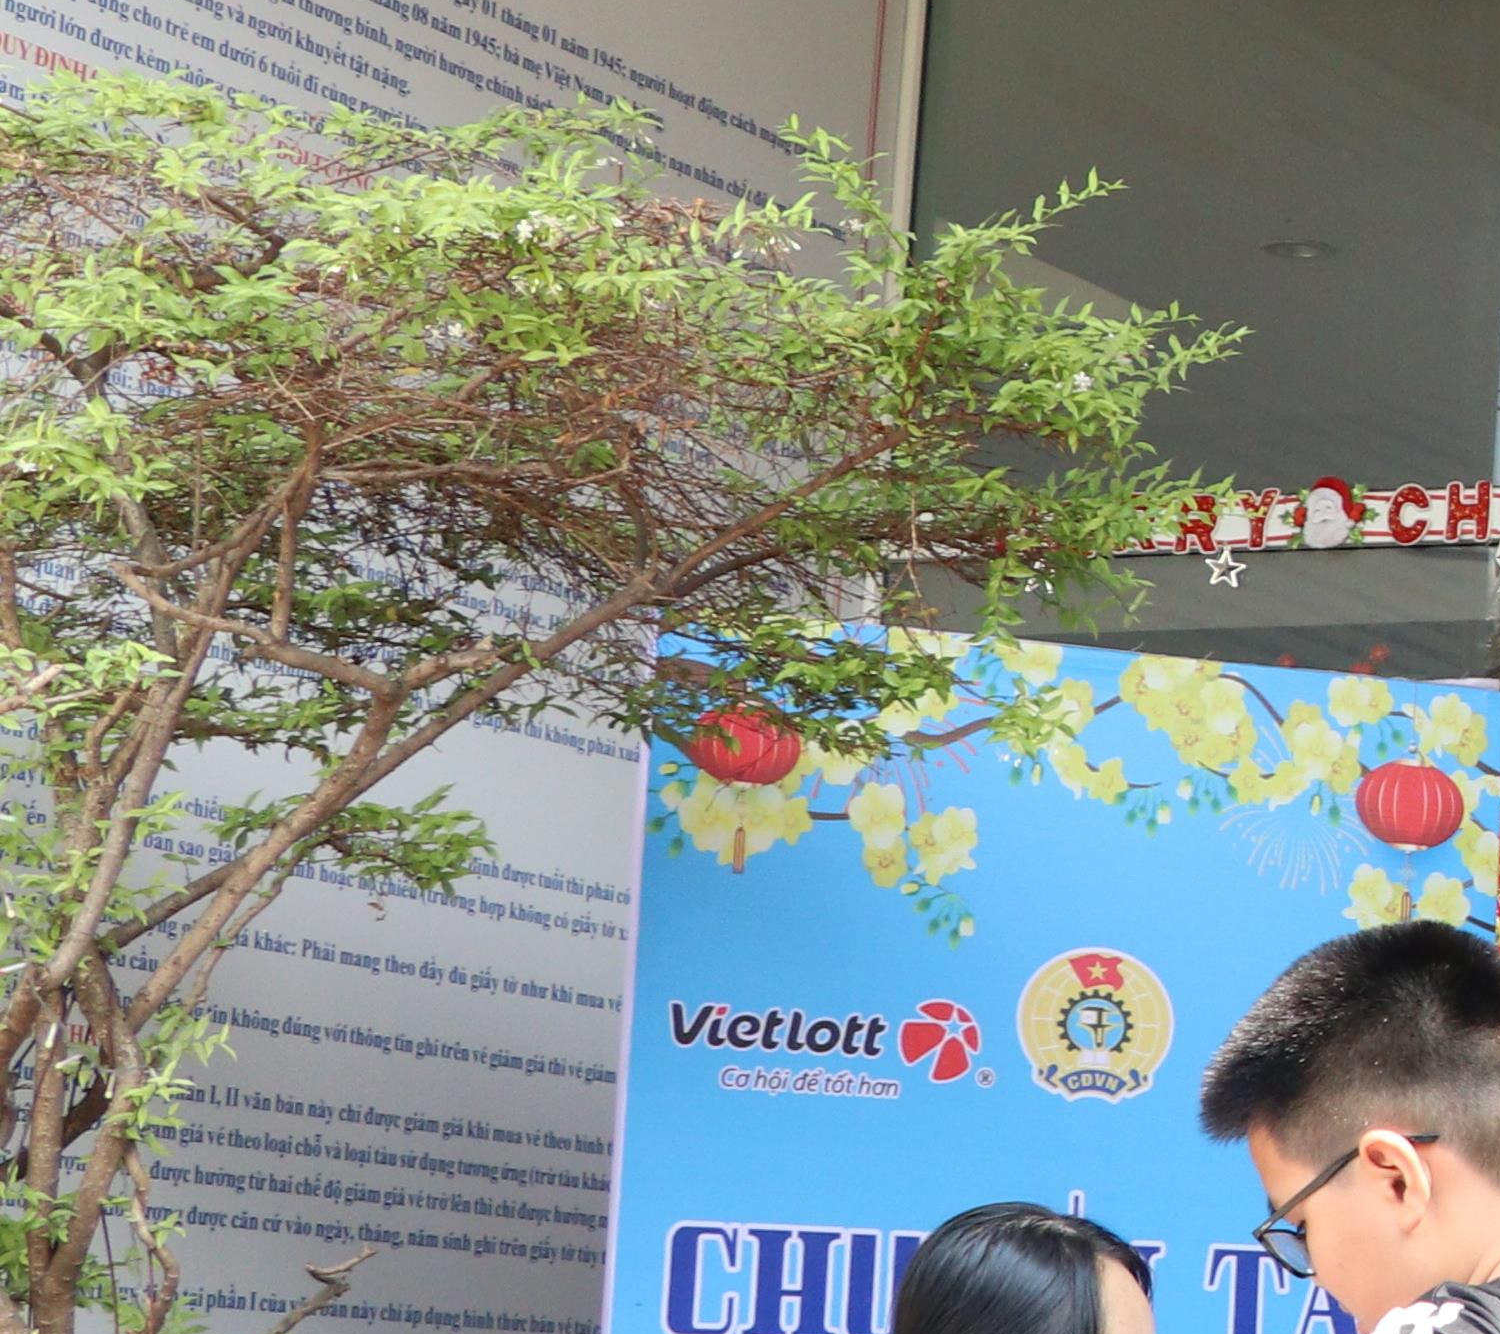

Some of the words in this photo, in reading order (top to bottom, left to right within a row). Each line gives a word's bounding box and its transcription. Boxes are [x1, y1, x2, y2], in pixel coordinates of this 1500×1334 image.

[669, 1002, 888, 1057] Vietlott
[720, 1067, 754, 1088] Cơ
[755, 1068, 790, 1093] hội
[793, 1066, 820, 1091] để
[823, 1069, 855, 1094] tốt
[858, 1074, 899, 1097] hơn
